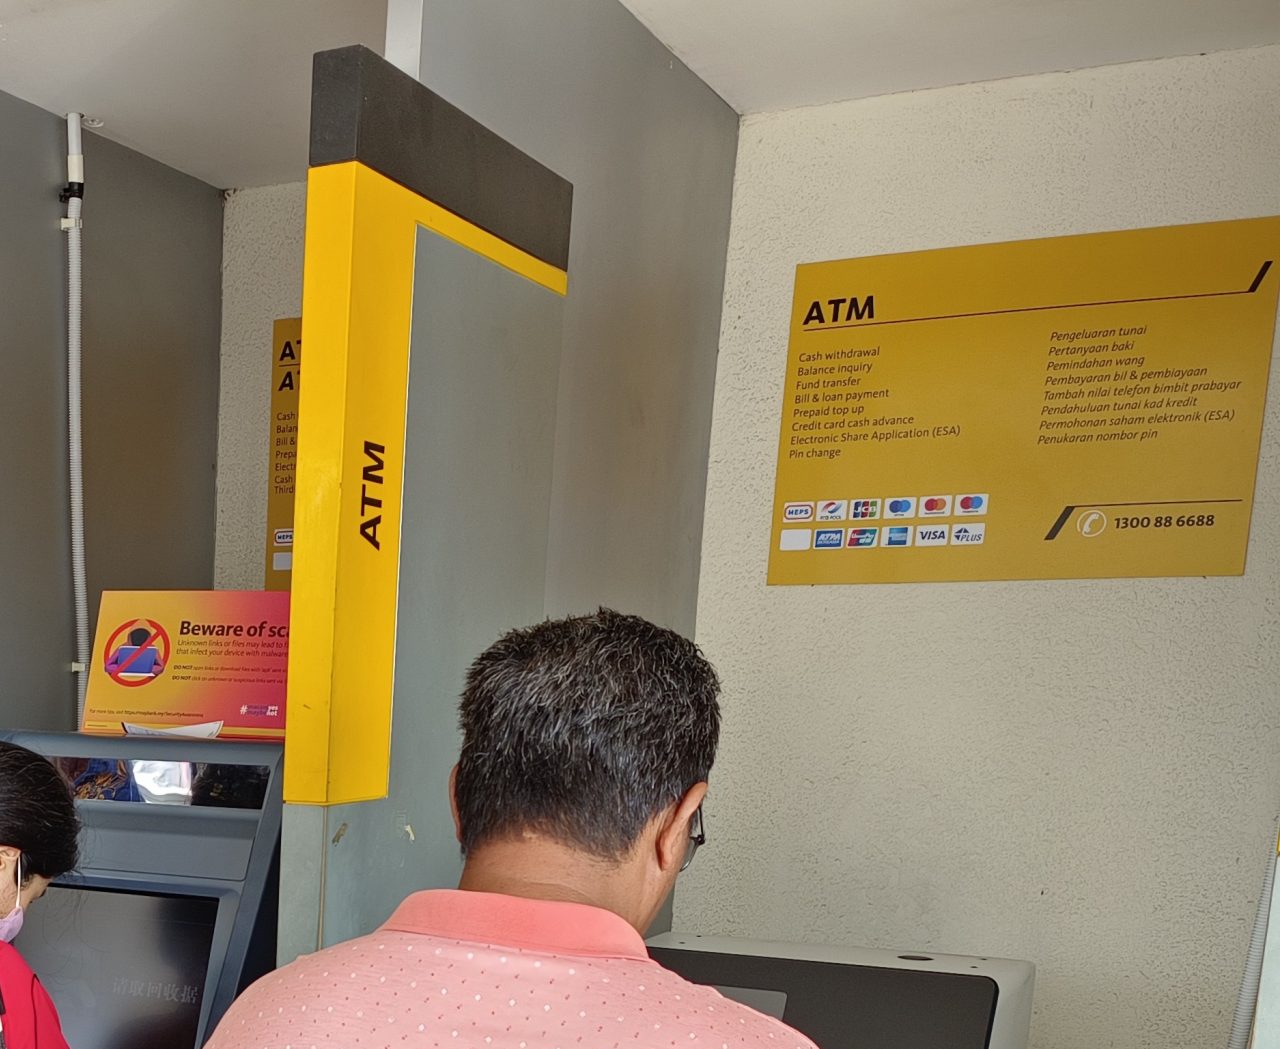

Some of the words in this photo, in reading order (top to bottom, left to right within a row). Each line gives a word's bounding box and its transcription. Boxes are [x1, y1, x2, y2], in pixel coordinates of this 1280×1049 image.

[802, 295, 875, 326] ATM
[1050, 328, 1116, 343] Pengeluaran
[1119, 325, 1148, 337] tunai
[279, 340, 301, 361] A
[798, 352, 823, 363] Cash
[825, 346, 880, 361] withdrawal
[1048, 343, 1109, 357] Pertanyaan
[1111, 340, 1135, 352] baki
[797, 365, 835, 377] Balance
[837, 362, 873, 375] inquiry
[1046, 358, 1113, 371] Pemindahan
[1115, 356, 1145, 367] wang
[278, 371, 300, 391] A
[796, 380, 820, 390] Fund
[822, 376, 862, 389] transfer
[1044, 373, 1111, 387] Pembayaran
[1113, 371, 1127, 382] bil
[1140, 367, 1208, 381] pembiayaan
[794, 393, 810, 404] Bill
[822, 391, 843, 402] loan
[845, 389, 889, 402] payment
[1043, 390, 1085, 401] Tambah
[1087, 387, 1110, 398] nilai
[1113, 384, 1150, 398] telefon
[1153, 382, 1190, 394] bimbit
[1191, 380, 1242, 394] prabayar
[793, 406, 830, 419] Prepaid
[832, 406, 849, 416] top
[851, 404, 865, 415] up
[1040, 403, 1110, 416] Pendahuluan
[1112, 399, 1141, 411] tunai
[1143, 398, 1163, 409] kad
[1166, 396, 1198, 407] kredit
[276, 411, 296, 421] Cash
[792, 419, 821, 432] Credit
[823, 418, 845, 430] card
[847, 416, 870, 428] cash
[872, 415, 914, 427] advance
[1039, 418, 1107, 431] Permohonan
[1109, 415, 1145, 426] saham
[1147, 411, 1201, 424] elektronik
[1204, 409, 1236, 423] (ESA)
[276, 437, 288, 447] Bill
[790, 433, 839, 446] Electronic
[841, 431, 869, 442] Share
[871, 428, 929, 442] Application
[932, 425, 961, 439] (ESA)
[1037, 433, 1093, 445] Penukaran
[1096, 430, 1139, 442] nombor
[1140, 429, 1158, 441] pin
[789, 449, 804, 459] Pin
[806, 448, 841, 460] change
[274, 474, 293, 484] Cash
[274, 485, 294, 494] Third
[359, 440, 385, 551] ATM
[1114, 516, 1150, 529] 1300
[1153, 515, 1173, 528] 88
[1176, 514, 1215, 528] 6688
[919, 531, 946, 540] VISA
[960, 534, 982, 542] PLUS
[180, 621, 243, 637] Beware
[246, 621, 268, 637] of
[268, 625, 290, 638] sc
[208, 649, 223, 657] your
